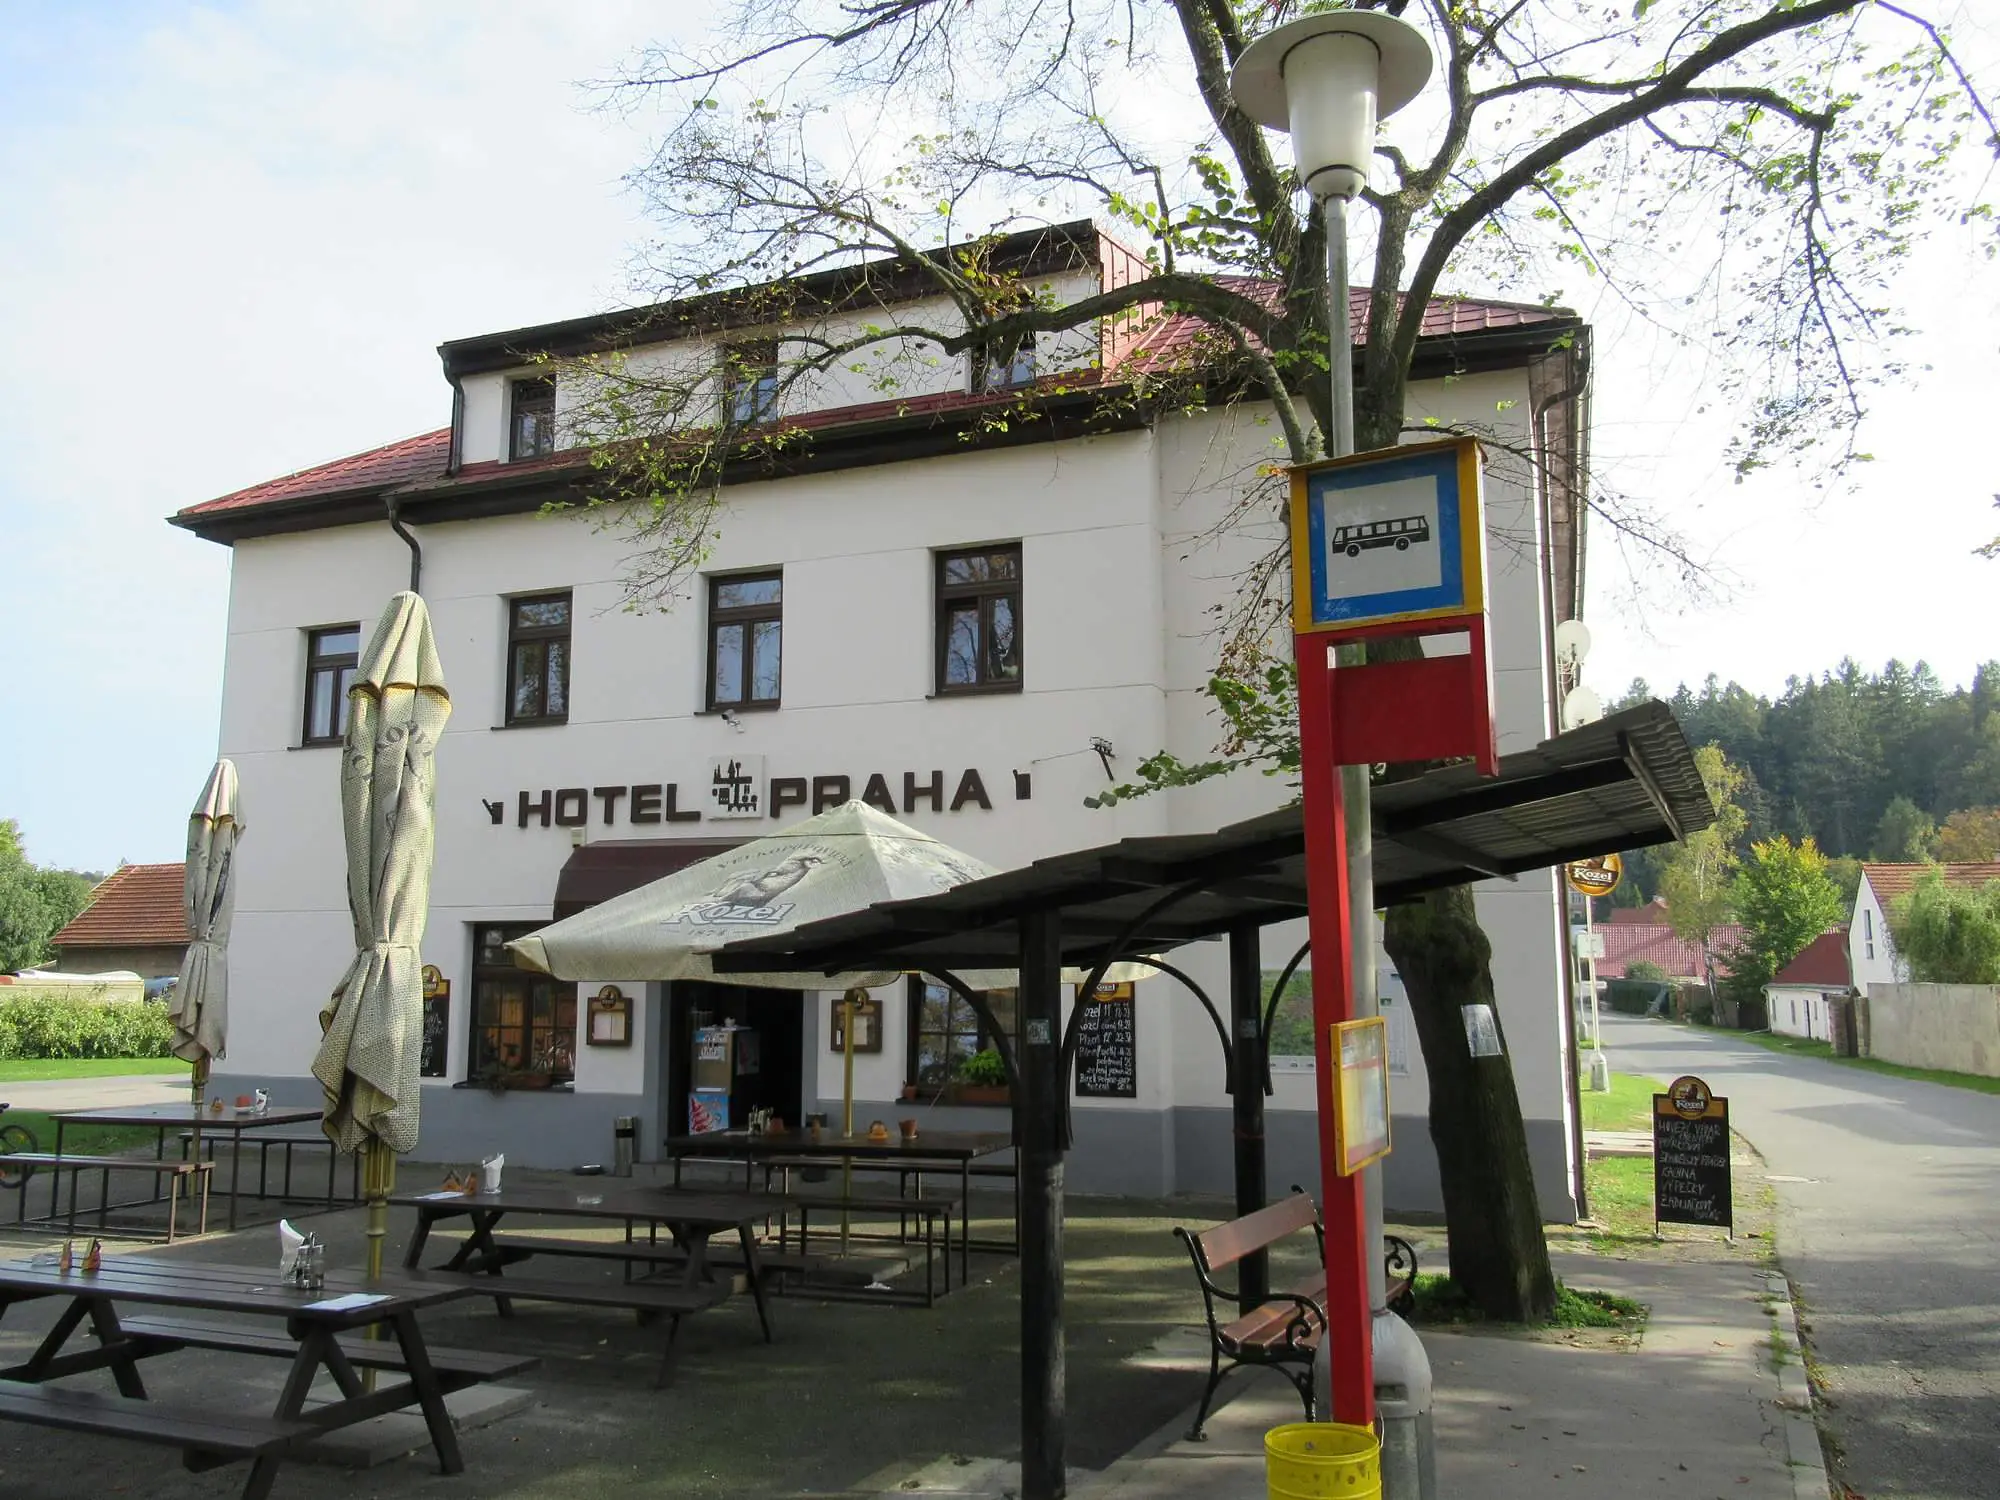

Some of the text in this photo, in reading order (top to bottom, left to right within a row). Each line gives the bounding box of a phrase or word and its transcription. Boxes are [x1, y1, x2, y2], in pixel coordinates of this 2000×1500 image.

[518, 768, 993, 829] HOTEL PRAHA
[1573, 867, 1612, 882] Kozel
[661, 901, 797, 925] Kozel
[1084, 1003, 1101, 1018] ozel
[1675, 1099, 1705, 1110] Kozel
